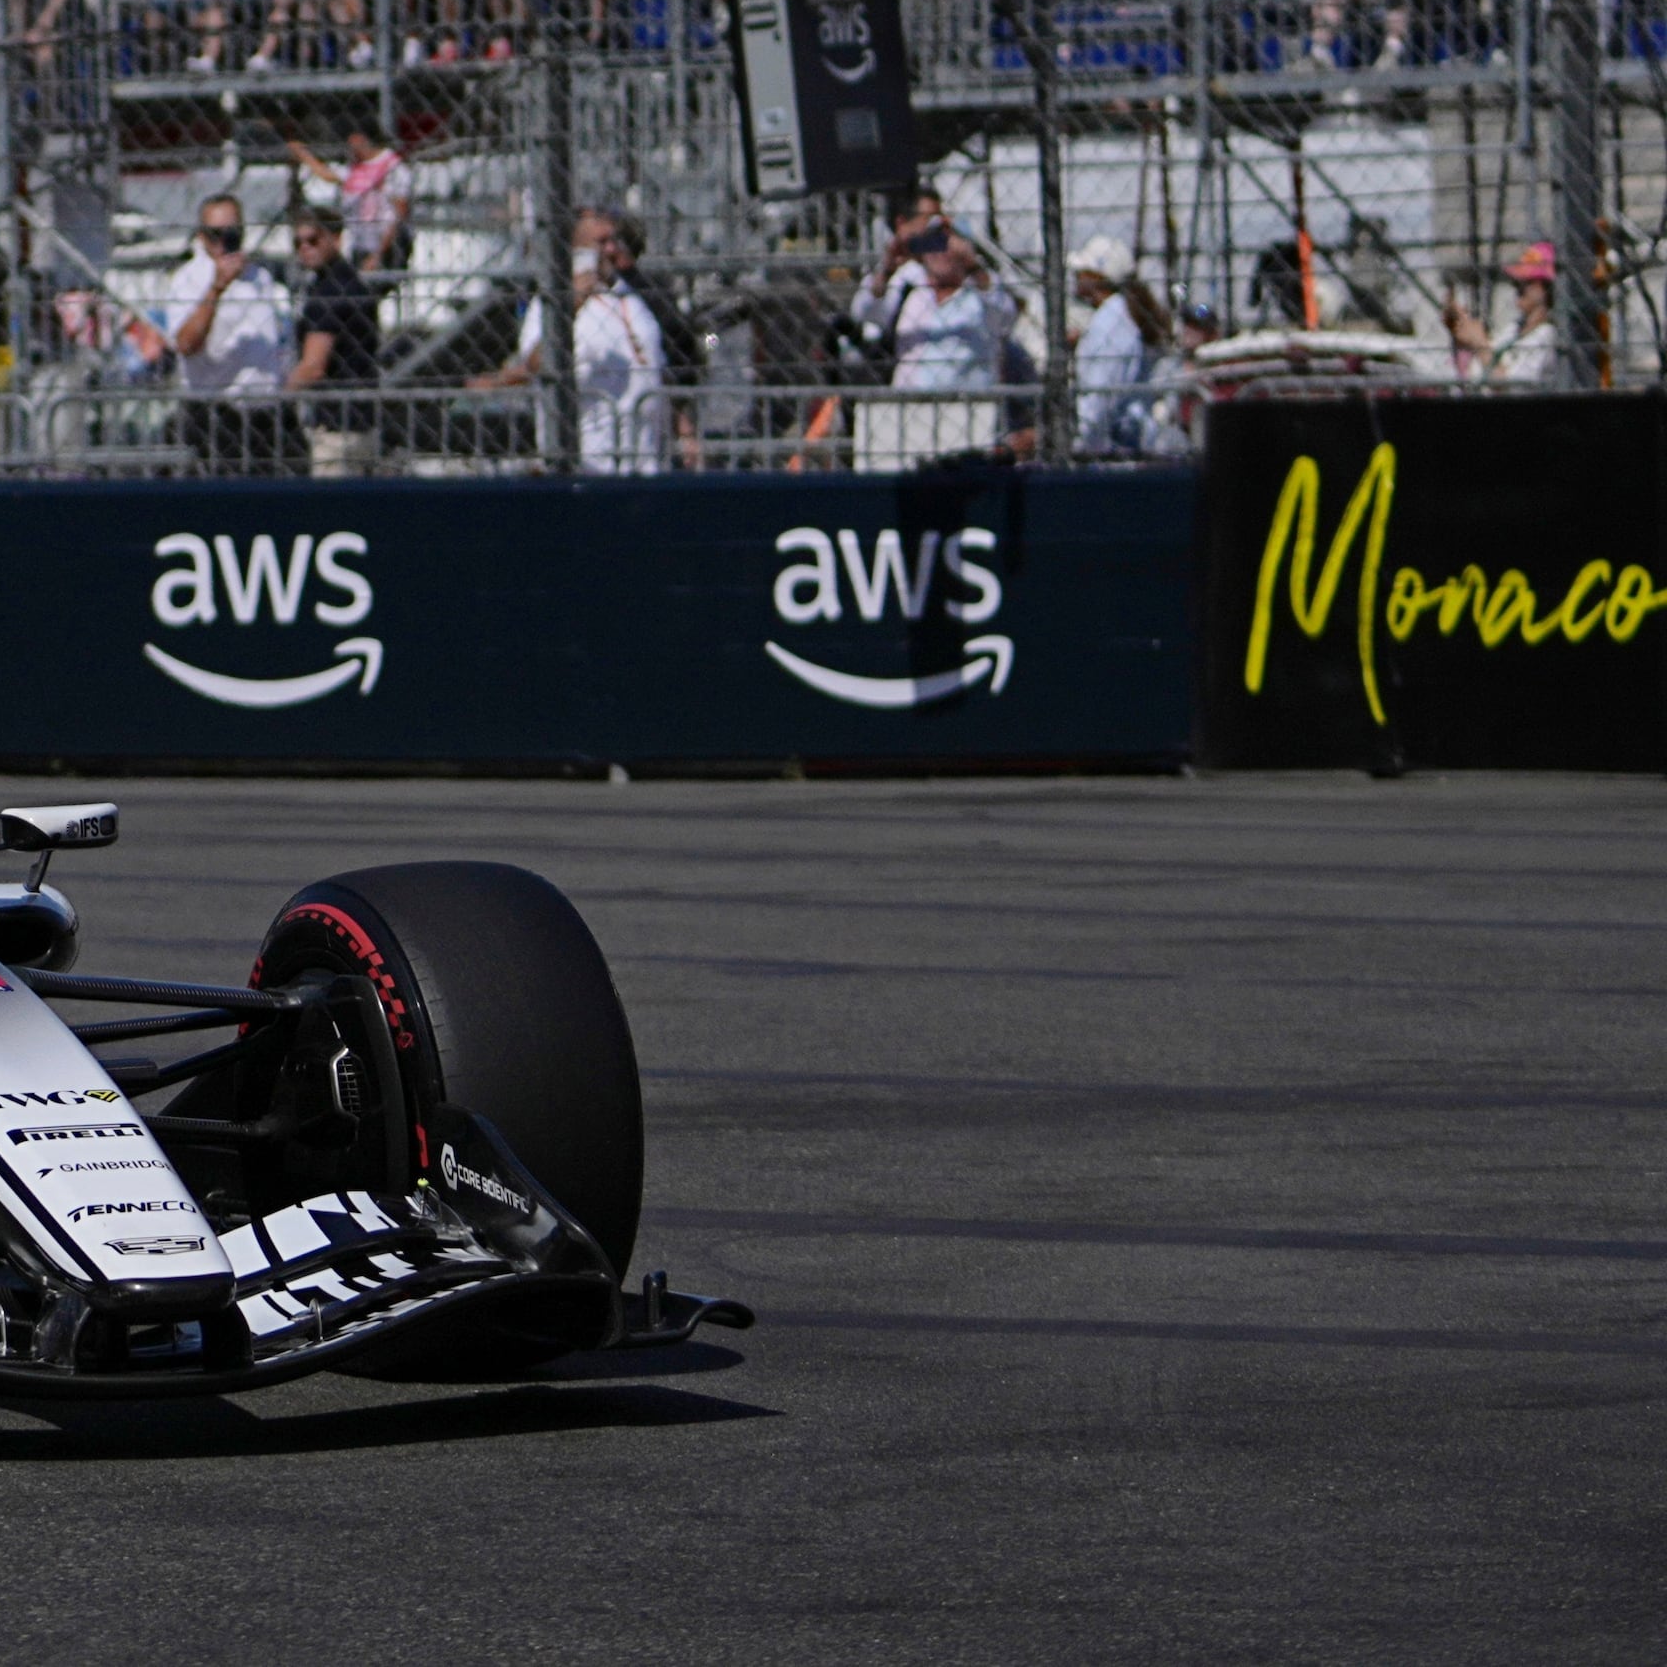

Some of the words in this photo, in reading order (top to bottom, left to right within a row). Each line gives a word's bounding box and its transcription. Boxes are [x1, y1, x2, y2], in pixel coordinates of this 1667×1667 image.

[152, 532, 372, 625] aws
[774, 527, 1001, 622] aws
[1245, 442, 1667, 724] Monaco
[79, 817, 99, 838] IFS
[7, 1123, 145, 1146] PIRELLI
[457, 1163, 482, 1191] CORE
[67, 1200, 197, 1223] TENNECO
